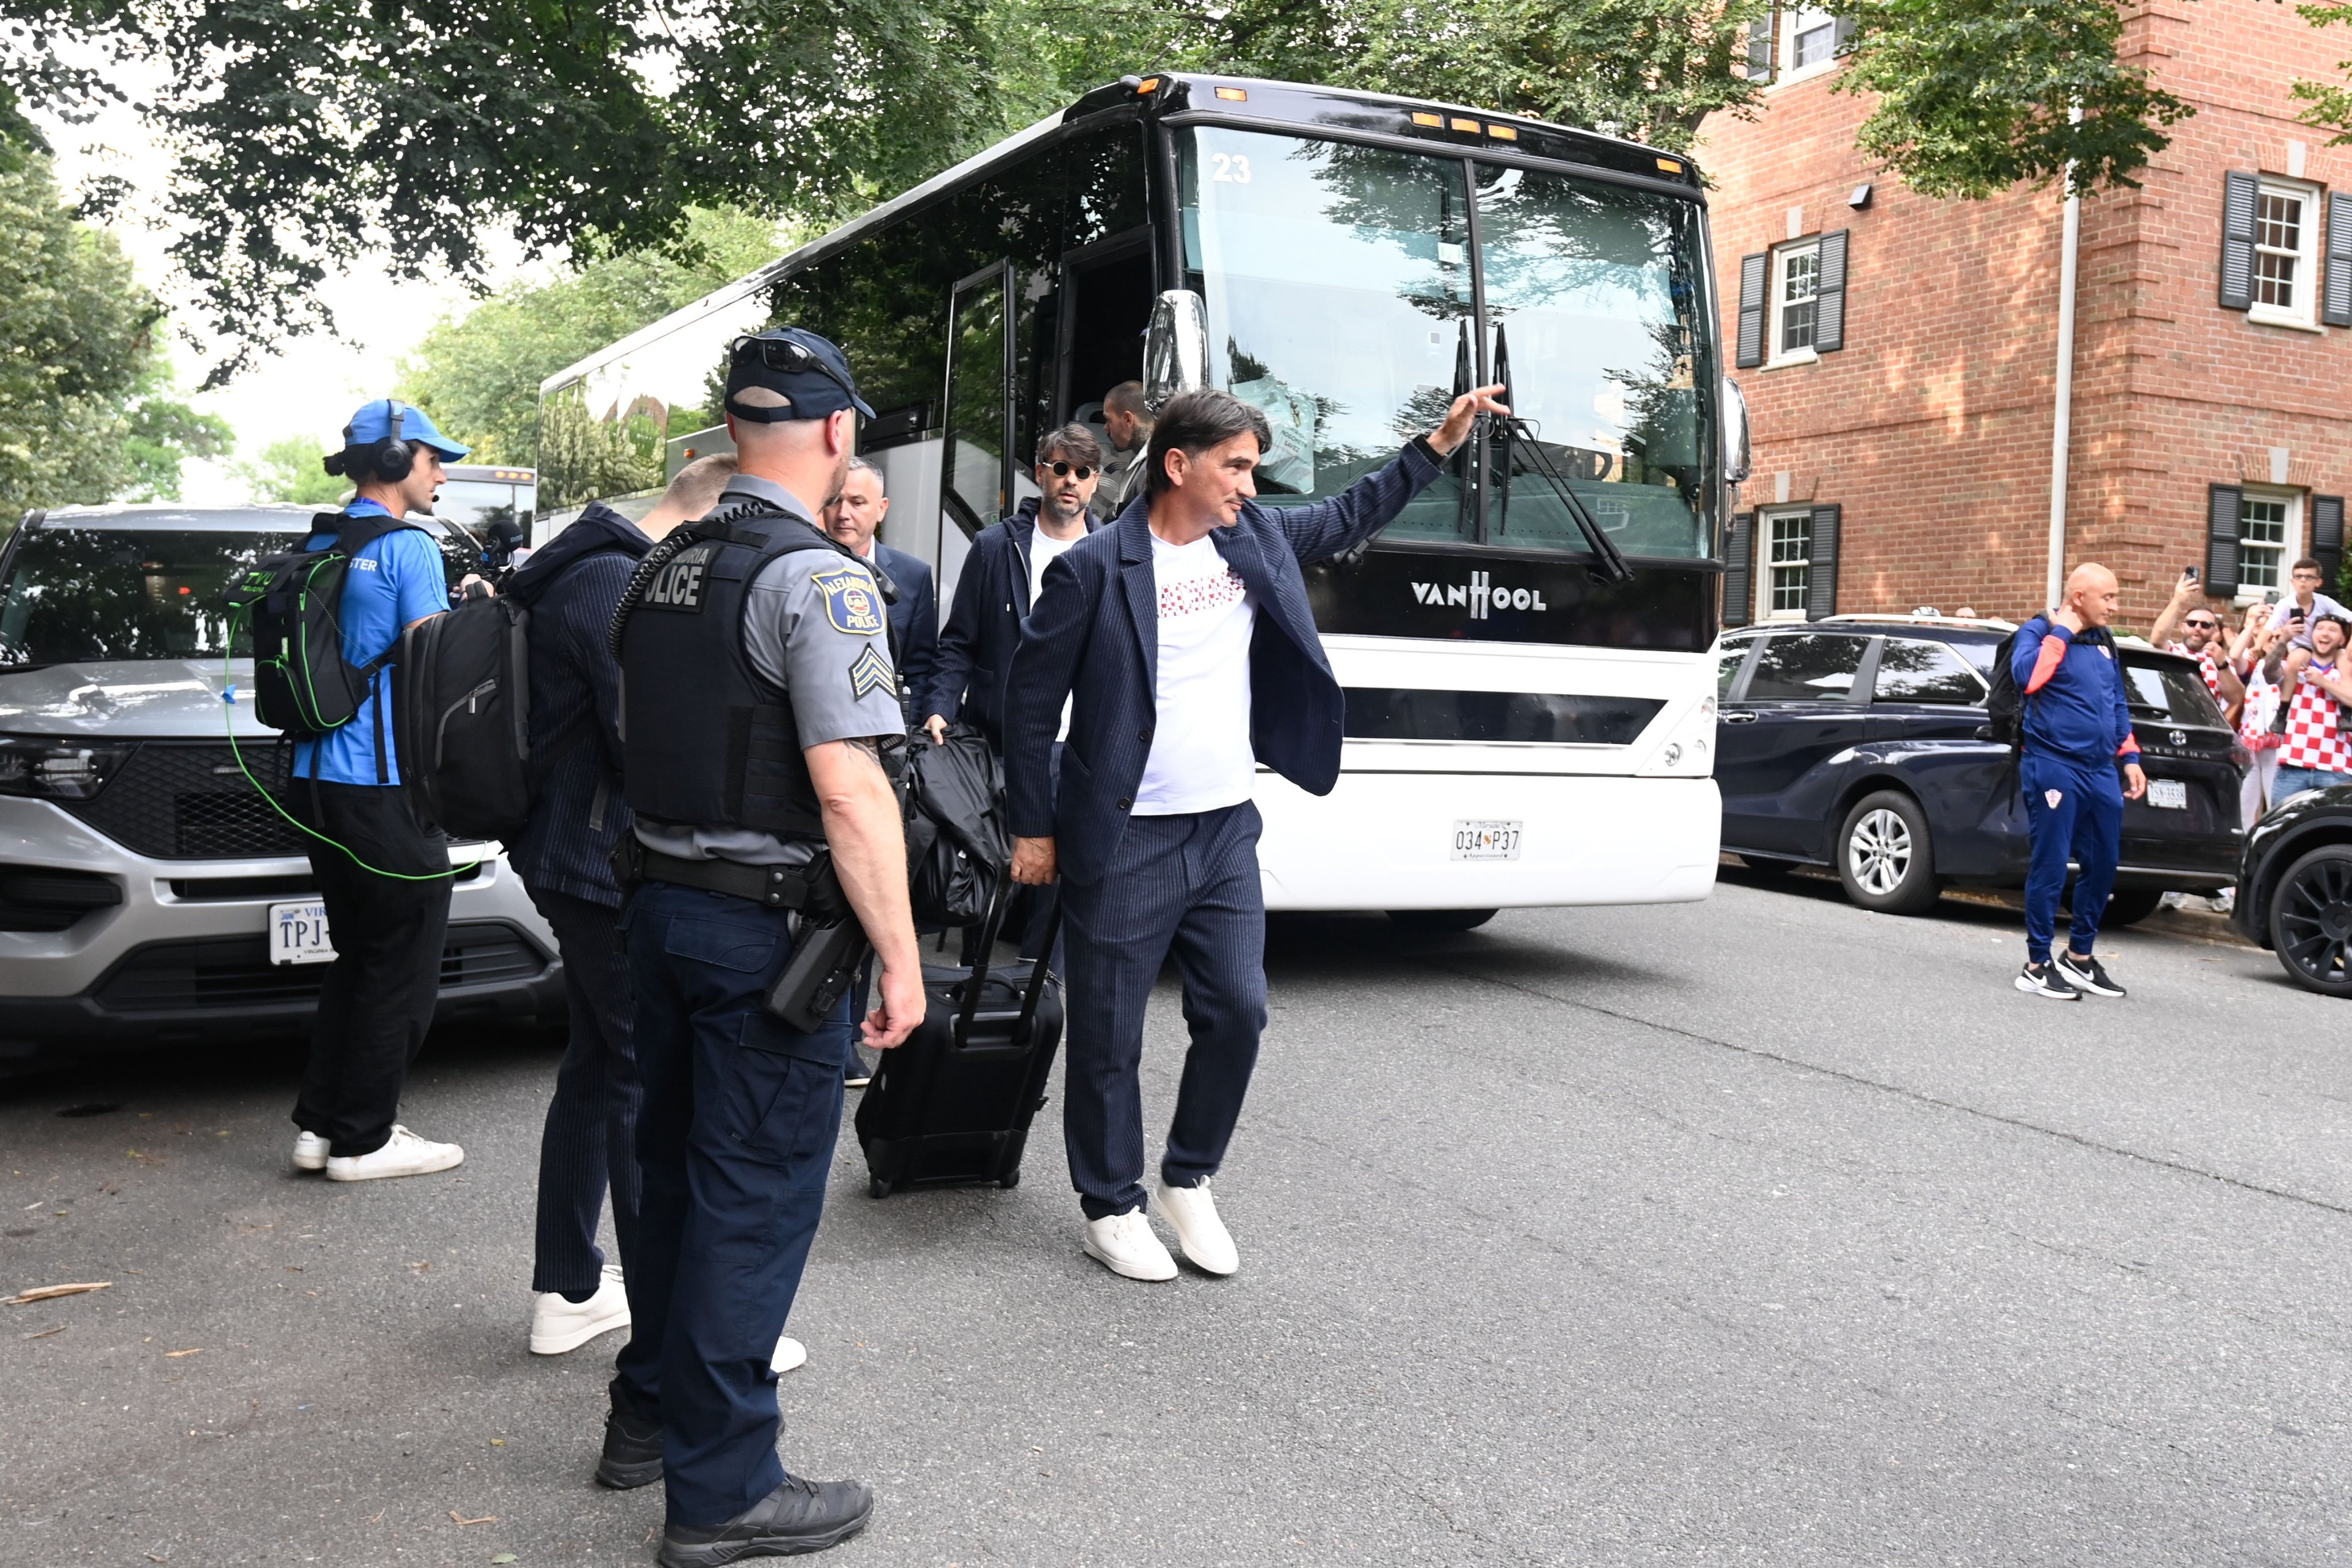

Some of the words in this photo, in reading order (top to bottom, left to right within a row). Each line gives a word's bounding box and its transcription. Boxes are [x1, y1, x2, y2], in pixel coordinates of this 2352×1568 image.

[1212, 152, 1252, 184] 23
[245, 572, 277, 585] TVU
[645, 565, 703, 606] OLICE
[825, 576, 873, 596] ALEXANDRIA
[846, 614, 880, 628] POLICE
[2142, 746, 2210, 758] SIENNA
